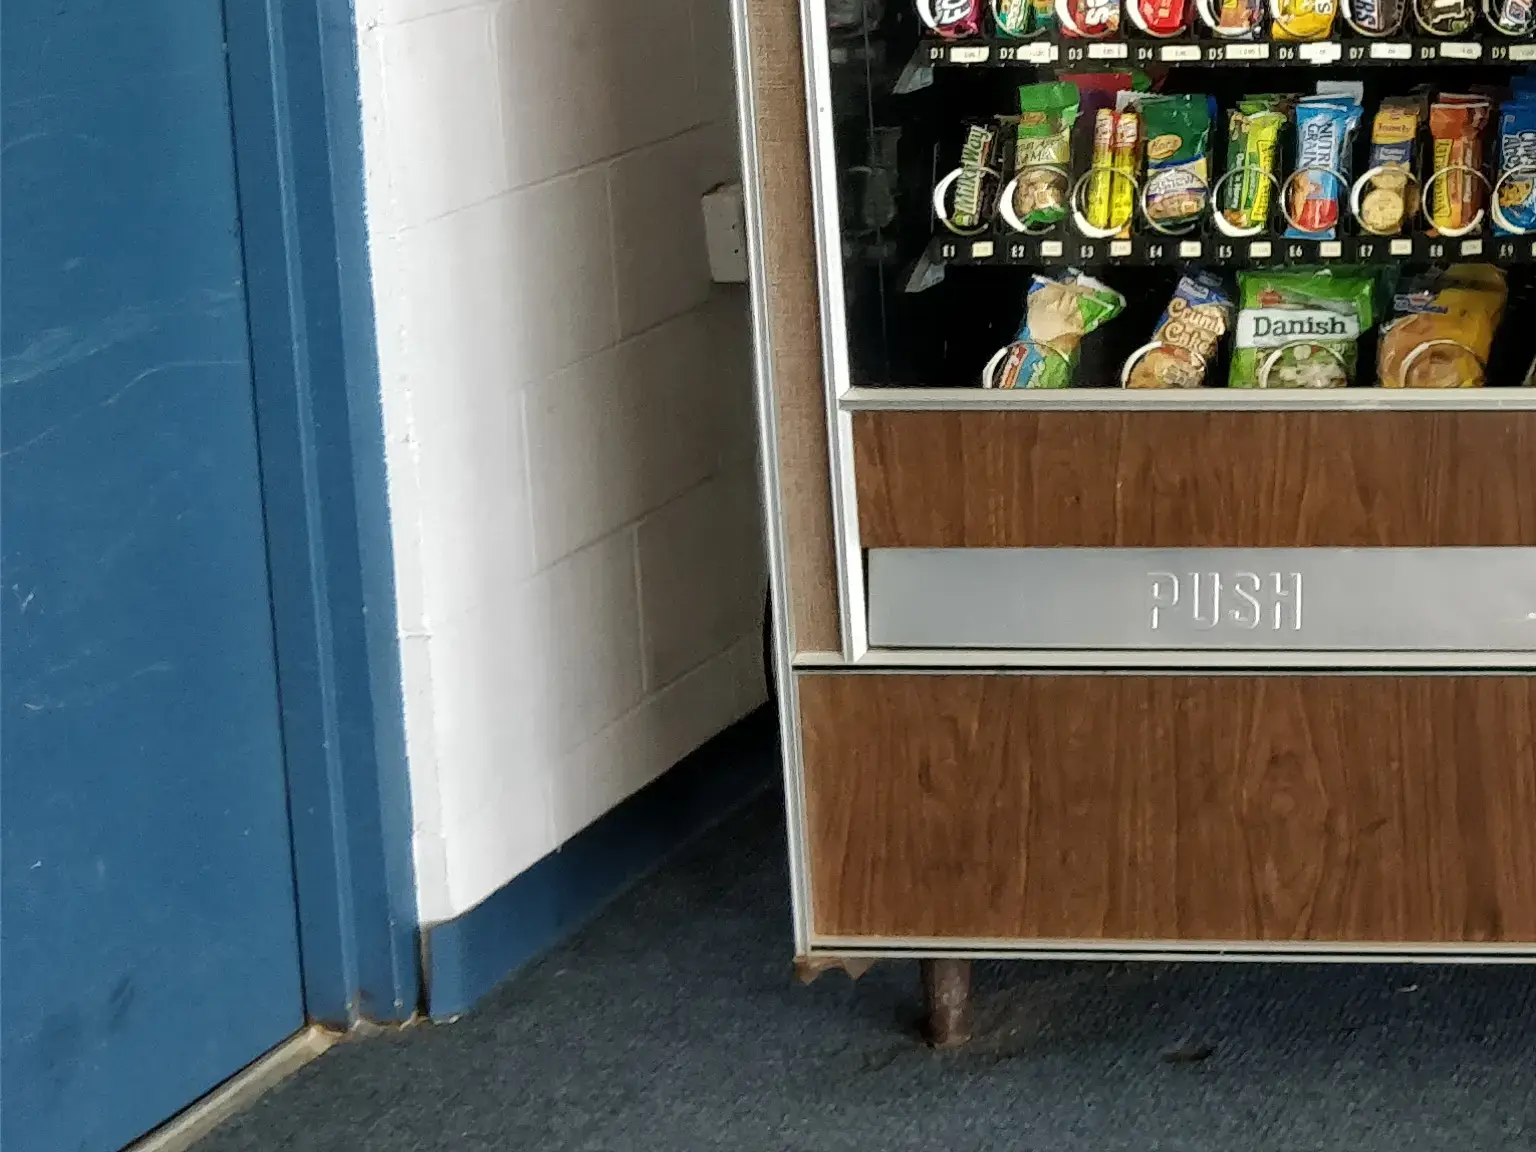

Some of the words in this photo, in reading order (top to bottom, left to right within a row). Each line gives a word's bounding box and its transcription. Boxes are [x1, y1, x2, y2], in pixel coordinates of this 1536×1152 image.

[930, 47, 945, 60] D1
[1000, 47, 1015, 60] D2
[1069, 48, 1084, 61] D3
[1138, 48, 1153, 60] D4
[1208, 48, 1224, 61] D5
[1279, 47, 1294, 60] D6
[1350, 47, 1364, 60] D7
[1421, 47, 1436, 60] D8
[1492, 46, 1507, 60] D9
[1303, 123, 1318, 168] GRAIN
[1169, 297, 1226, 336] Crumb
[1253, 316, 1346, 338] Danish
[1148, 572, 1304, 630] PUSH
